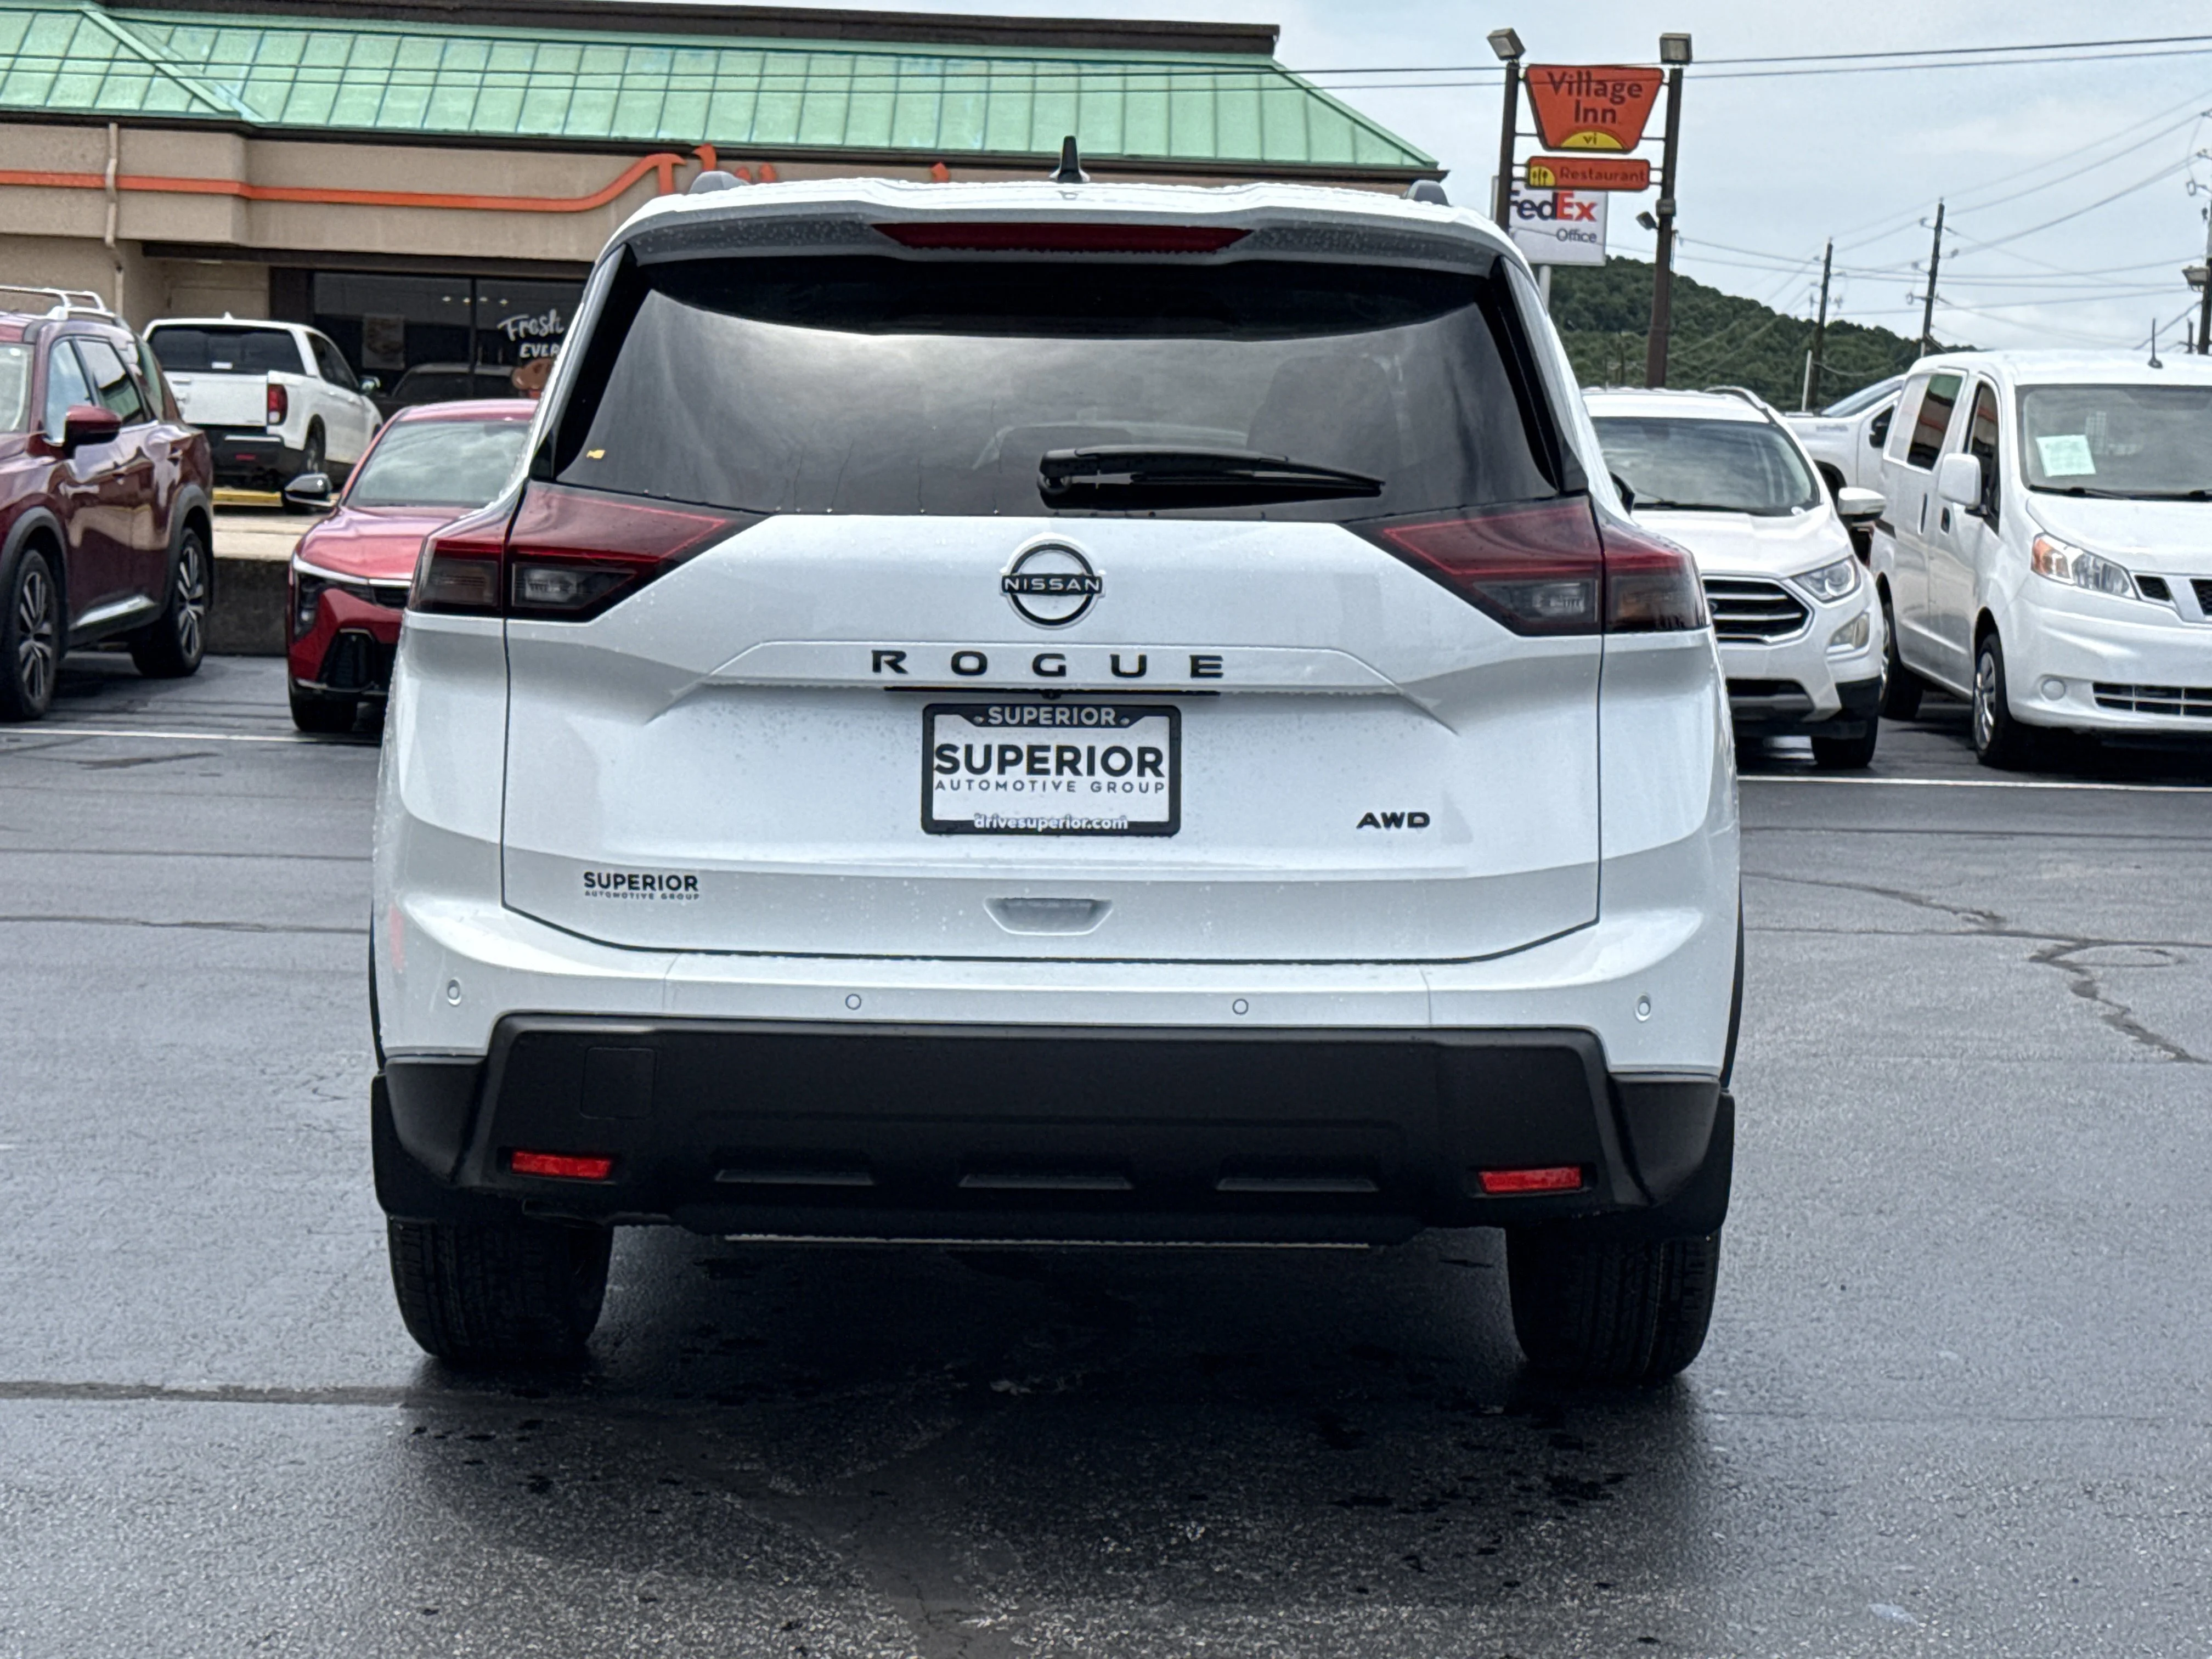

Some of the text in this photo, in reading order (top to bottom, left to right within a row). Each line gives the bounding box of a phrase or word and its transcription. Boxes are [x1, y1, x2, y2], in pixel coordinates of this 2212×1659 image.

[1548, 70, 1643, 105] Village
[1573, 99, 1617, 124] Inn
[1583, 133, 1598, 145] vi
[1560, 166, 1645, 183] Restaurant
[1556, 228, 1597, 243] Office
[497, 308, 565, 341] Fresh
[1004, 578, 1101, 591] NISSAN
[871, 650, 1224, 679] ROGUE
[988, 707, 1116, 726] SUPERIOR
[934, 743, 1165, 778] SUPERIOR
[935, 780, 1165, 794] AUTOMOTIVE GROUP
[974, 814, 1128, 832] drivesuperior.com
[1356, 811, 1430, 829] AWD
[583, 871, 698, 891] SUPERIOR
[585, 891, 654, 900] AUTOMOTIVE
